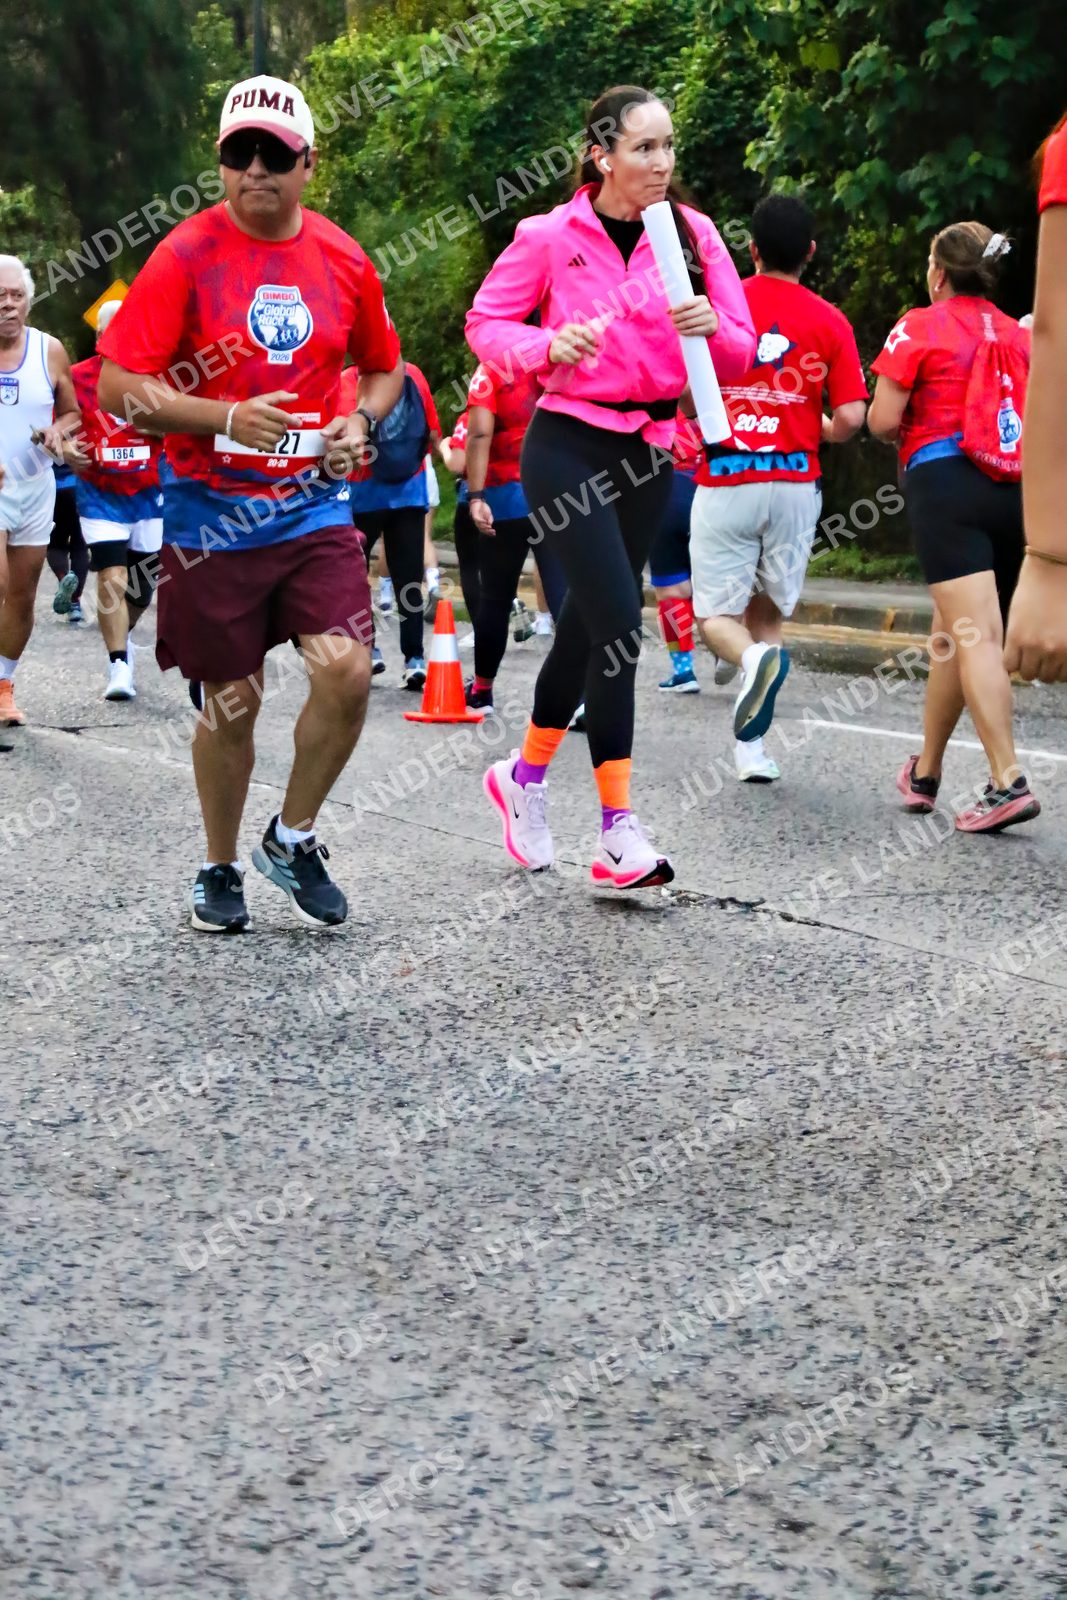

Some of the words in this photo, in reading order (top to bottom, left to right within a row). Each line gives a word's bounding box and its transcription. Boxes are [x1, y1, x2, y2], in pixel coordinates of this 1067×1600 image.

[230, 88, 295, 117] PUMA
[262, 292, 295, 301] BIMBO
[264, 304, 296, 316] Global
[258, 314, 285, 326] Race
[270, 352, 290, 362] 2026
[734, 413, 780, 434] 20-26
[262, 432, 301, 454] 27
[112, 447, 134, 460] 1364
